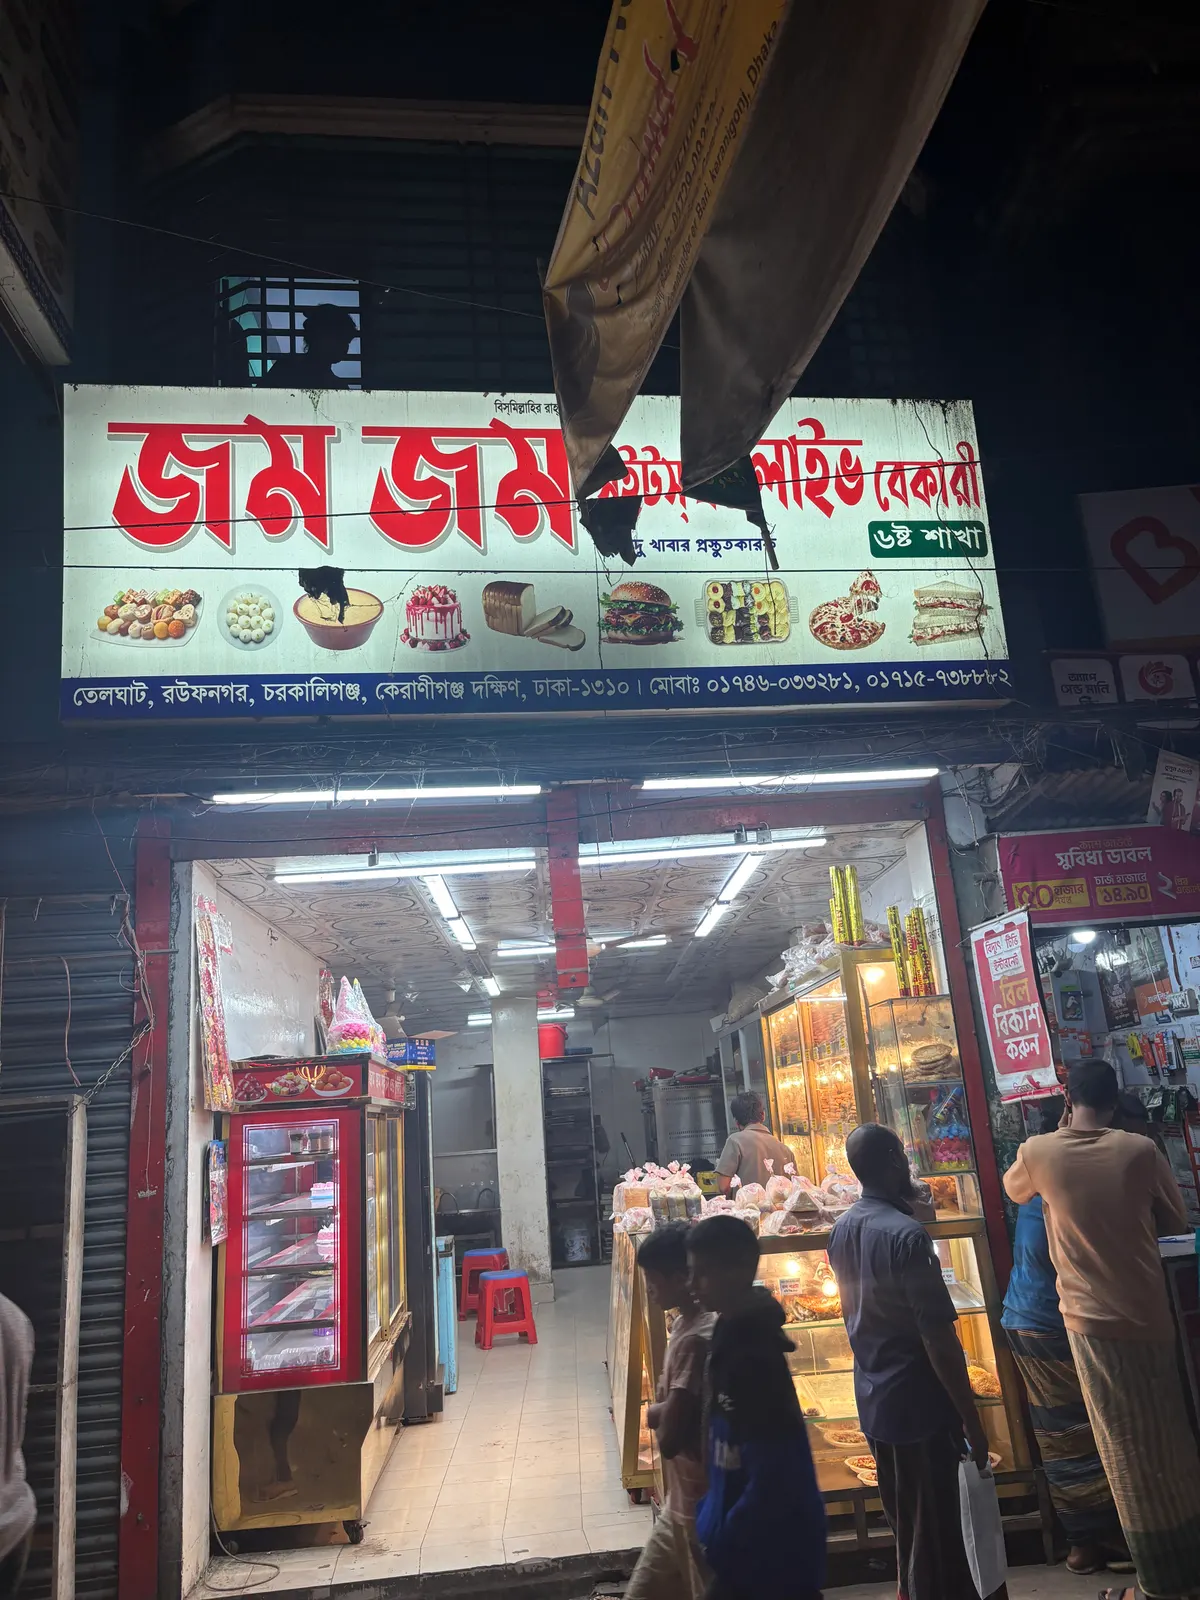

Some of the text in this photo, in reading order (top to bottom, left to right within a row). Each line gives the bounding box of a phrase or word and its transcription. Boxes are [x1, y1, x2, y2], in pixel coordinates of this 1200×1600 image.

[108, 414, 338, 552] জম
[362, 417, 577, 552] জম
[874, 441, 982, 512] বেকারী
[649, 539, 691, 553] খাবার
[921, 526, 982, 550] শাখা
[73, 680, 154, 709] তেলঘাট,
[161, 679, 255, 707] রউফনগর,
[262, 676, 367, 705] চরকালিগঞ্জ,
[375, 675, 464, 701] কেরাণীগঞ্জ
[470, 675, 527, 702] দক্ষিণ,
[532, 676, 630, 698] ঢাকা-১৩১০
[707, 671, 860, 693] ০১৭৪৬-০৩৩২৮১,
[867, 668, 1012, 690] ০১৭১৫-৭৩৮৮৮২
[1055, 846, 1152, 871] সুবিধা ডাবল
[1053, 883, 1084, 895] হাজার
[1094, 872, 1147, 885] চার্জ হাজারে
[1000, 975, 1031, 1009] বিল
[993, 1003, 1042, 1038] বিকাশ
[1003, 1033, 1040, 1061] করুন
